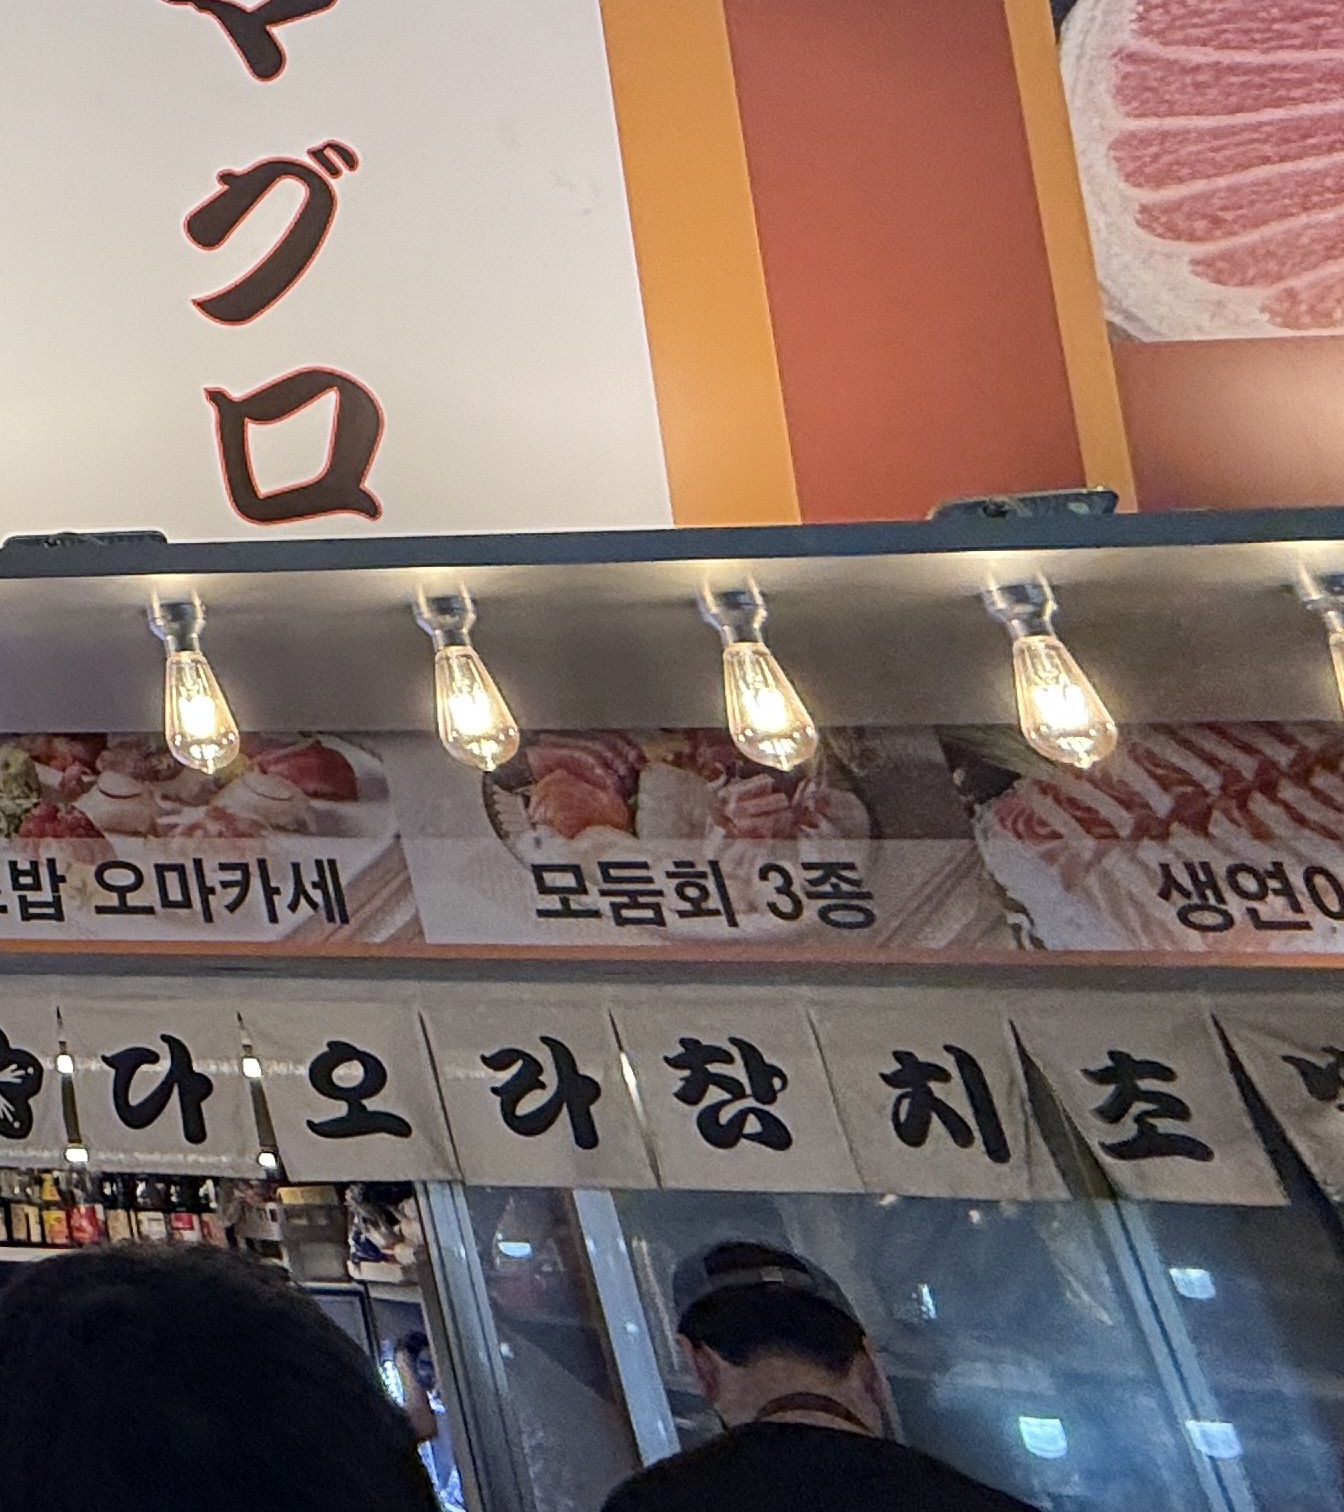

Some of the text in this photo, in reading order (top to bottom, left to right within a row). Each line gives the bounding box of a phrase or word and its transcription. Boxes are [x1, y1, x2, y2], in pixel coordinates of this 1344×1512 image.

[93, 856, 350, 925] 오마카세
[530, 859, 877, 932] 모둠회 3종
